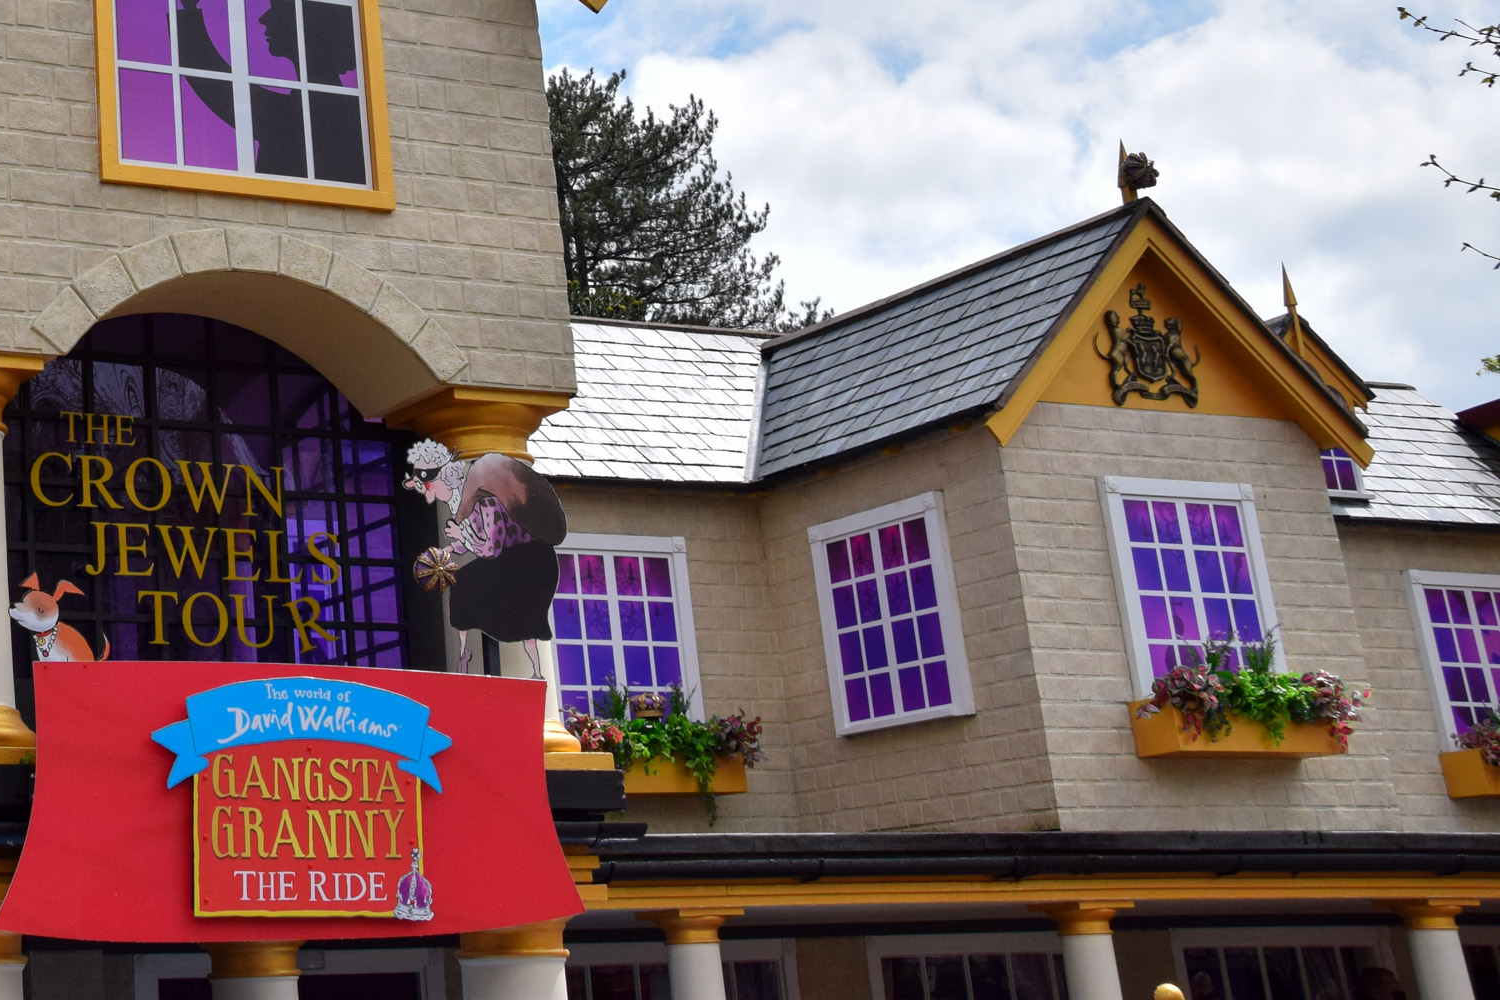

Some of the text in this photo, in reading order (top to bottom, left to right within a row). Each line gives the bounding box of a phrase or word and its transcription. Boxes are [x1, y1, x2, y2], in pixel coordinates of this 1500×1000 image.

[60, 411, 137, 446] THE
[30, 452, 285, 518] CROWN
[85, 520, 341, 585] JEWELS
[138, 590, 340, 654] TOUR
[265, 684, 351, 702] The world of
[217, 702, 398, 744] David Walliams
[212, 754, 406, 802] GANGSTA
[211, 806, 405, 858] GRANNY
[234, 871, 388, 902] THE RIDE
